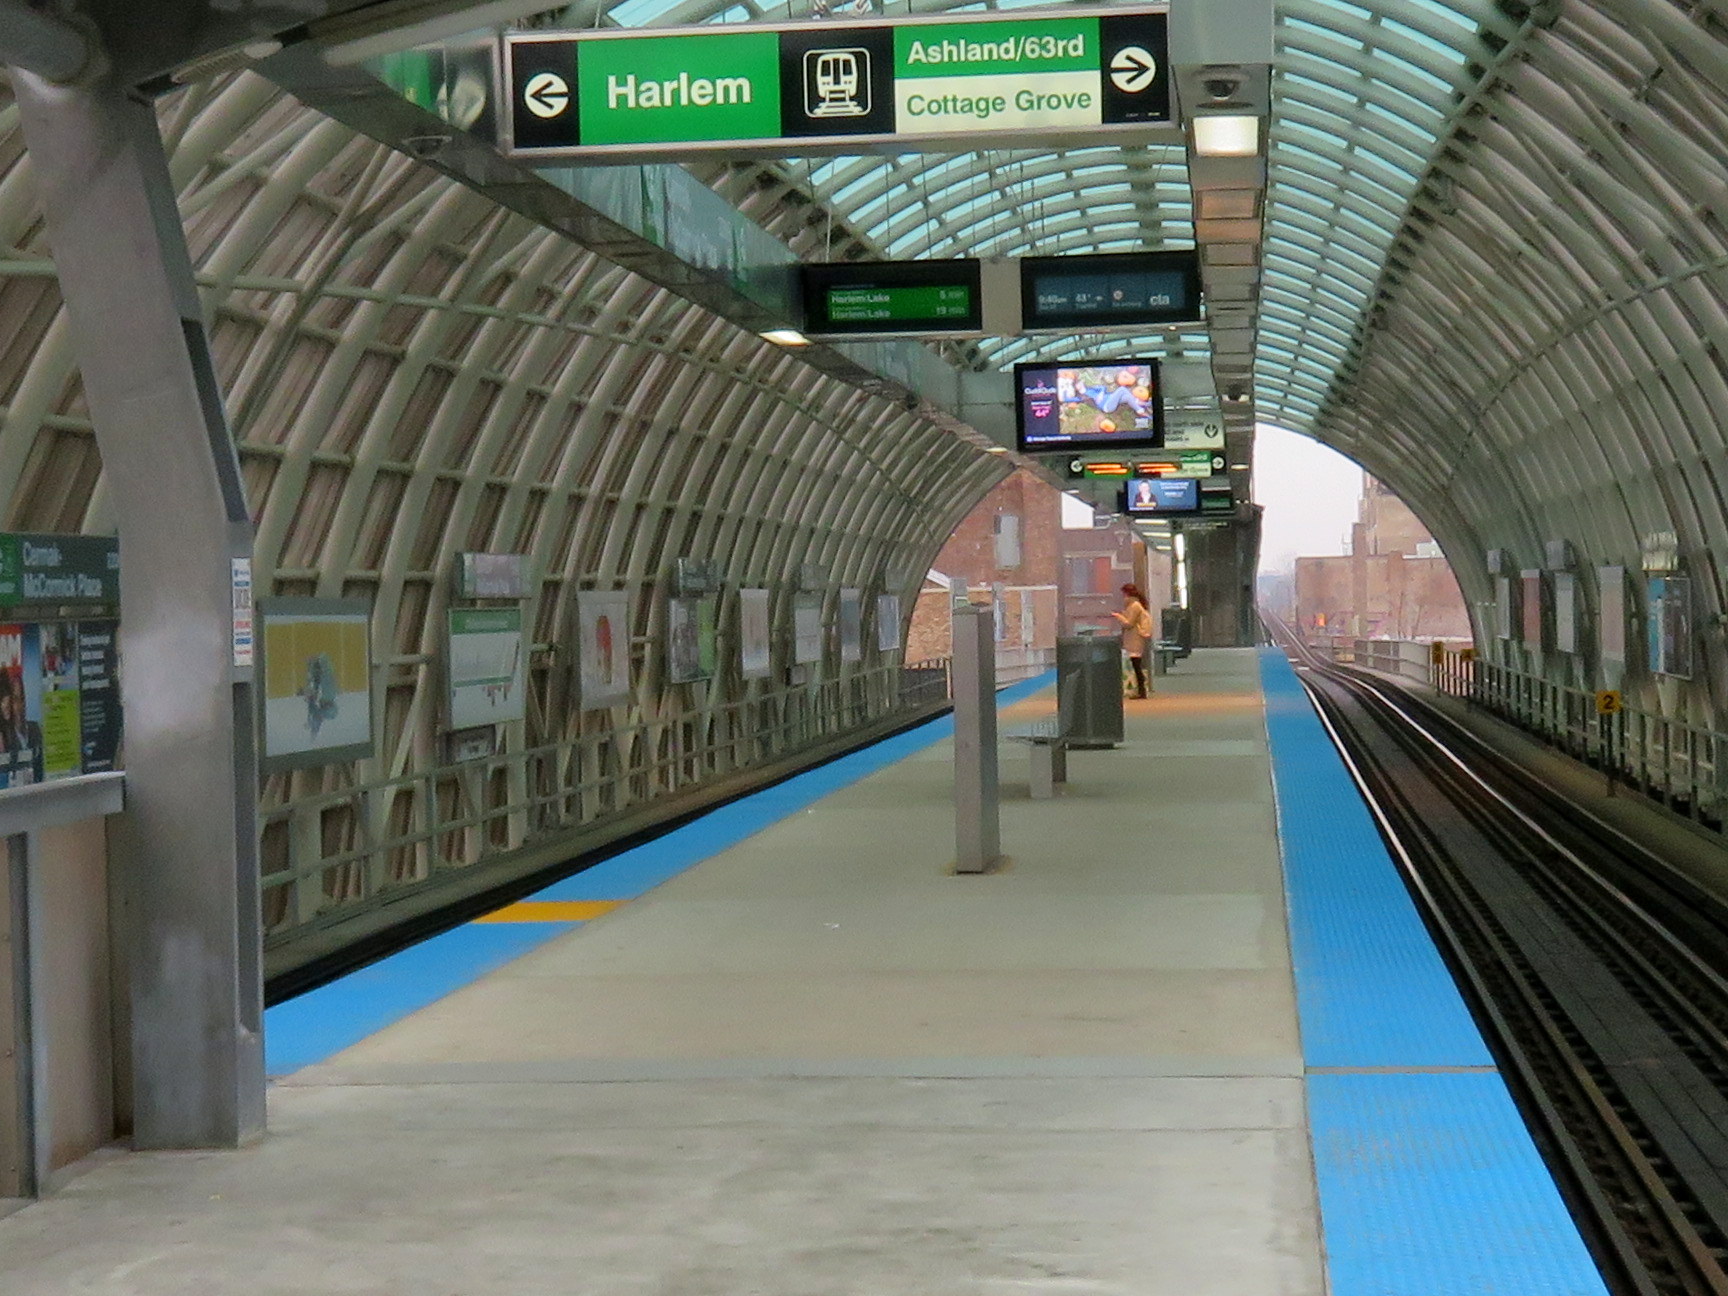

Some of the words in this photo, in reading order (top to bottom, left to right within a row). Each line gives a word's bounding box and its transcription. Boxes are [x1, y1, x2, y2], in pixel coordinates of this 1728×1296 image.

[907, 34, 1084, 65] Ashland/63rd
[607, 72, 752, 109] Harlem
[907, 94, 1006, 119] Cottage
[1015, 90, 1091, 112] Grove
[1602, 694, 1615, 710] 2
